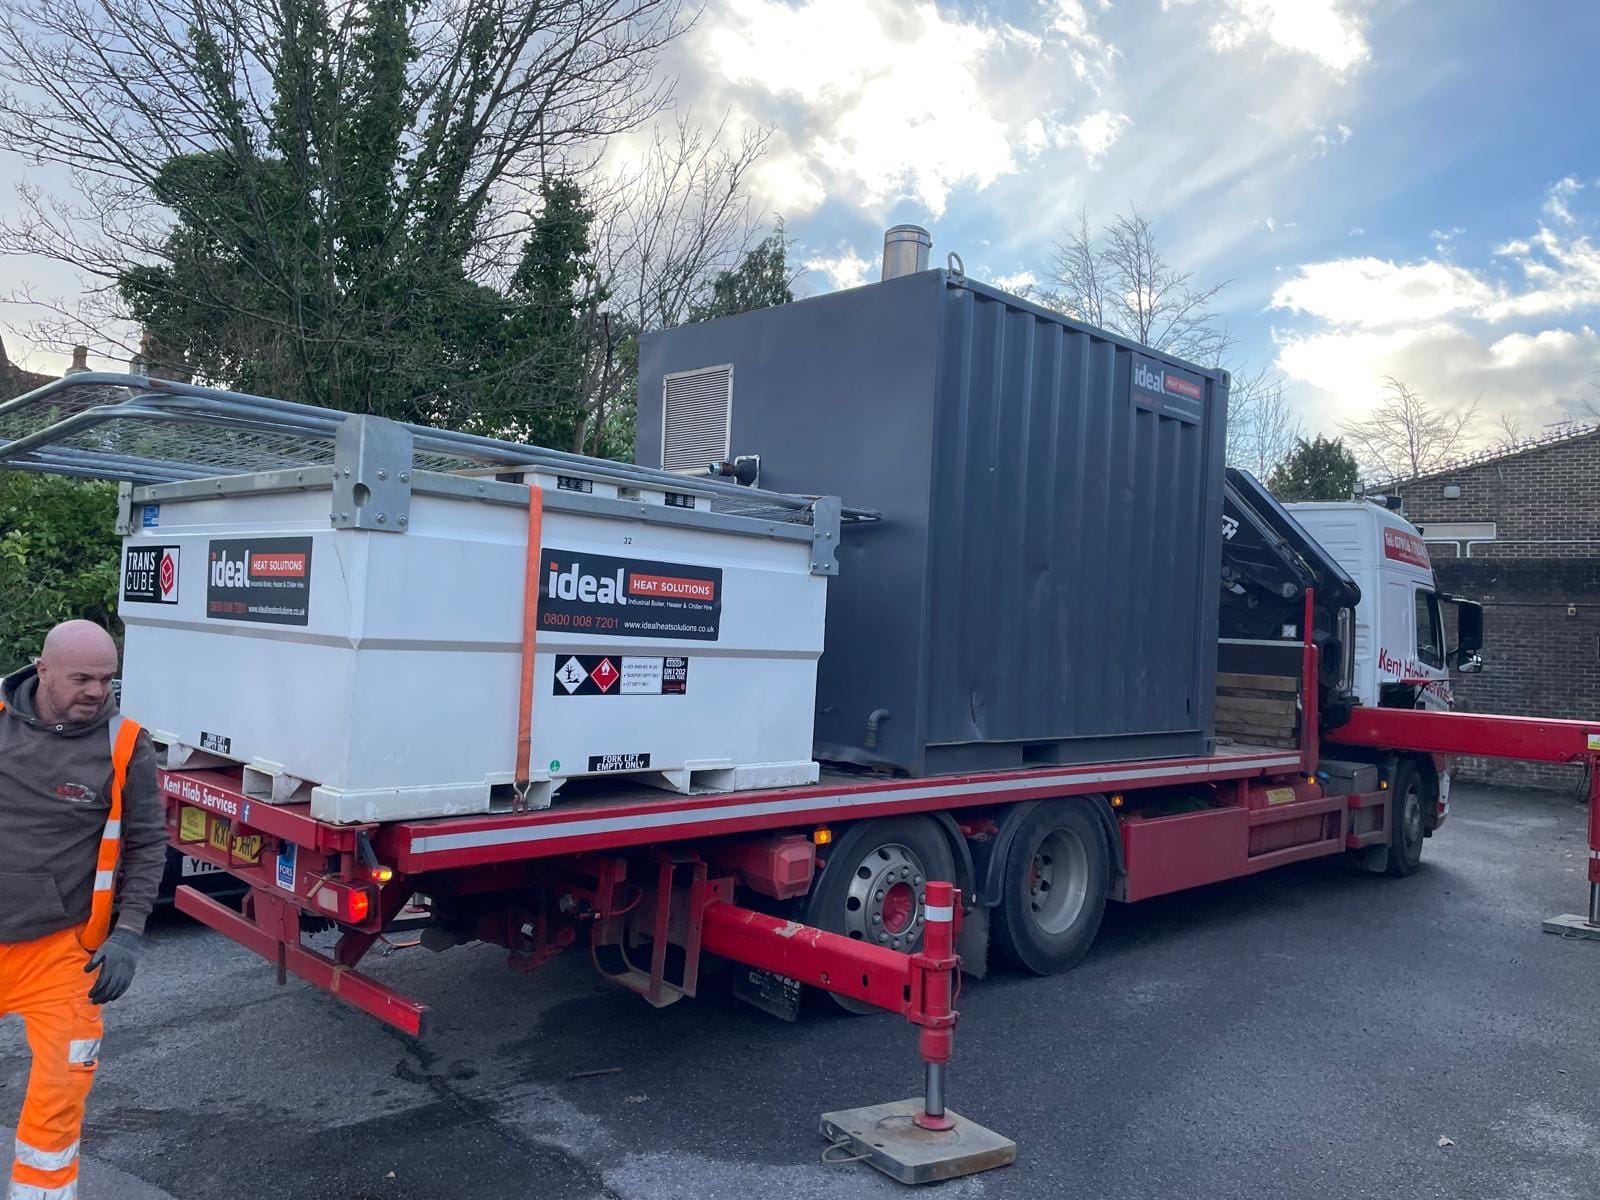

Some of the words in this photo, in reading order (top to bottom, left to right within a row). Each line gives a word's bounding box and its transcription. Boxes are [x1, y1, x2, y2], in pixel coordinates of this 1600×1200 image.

[1134, 362, 1165, 394] ideal
[624, 537, 632, 545] 32
[128, 551, 156, 570] TRANS
[211, 549, 250, 588] ideal
[253, 560, 268, 570] HEAT
[269, 560, 302, 571] SOLUTIONS
[126, 571, 154, 591] CUBE
[548, 561, 626, 606] ideal
[634, 580, 658, 591] HEAT
[661, 582, 710, 595] SOLUTIONS
[628, 598, 651, 606] Industrial
[543, 612, 570, 626] 0800
[572, 615, 592, 627] 008
[595, 616, 619, 628] 7201
[624, 620, 714, 633] www.idealheatsolutions.co.uk
[1378, 647, 1402, 677] Kent
[596, 762, 624, 771] EMPTY
[625, 760, 645, 769] ONLY
[602, 756, 622, 764] FORK
[164, 774, 180, 796] Kent
[182, 781, 200, 802] Hiab
[202, 788, 238, 816] Services
[280, 864, 292, 876] FORS
